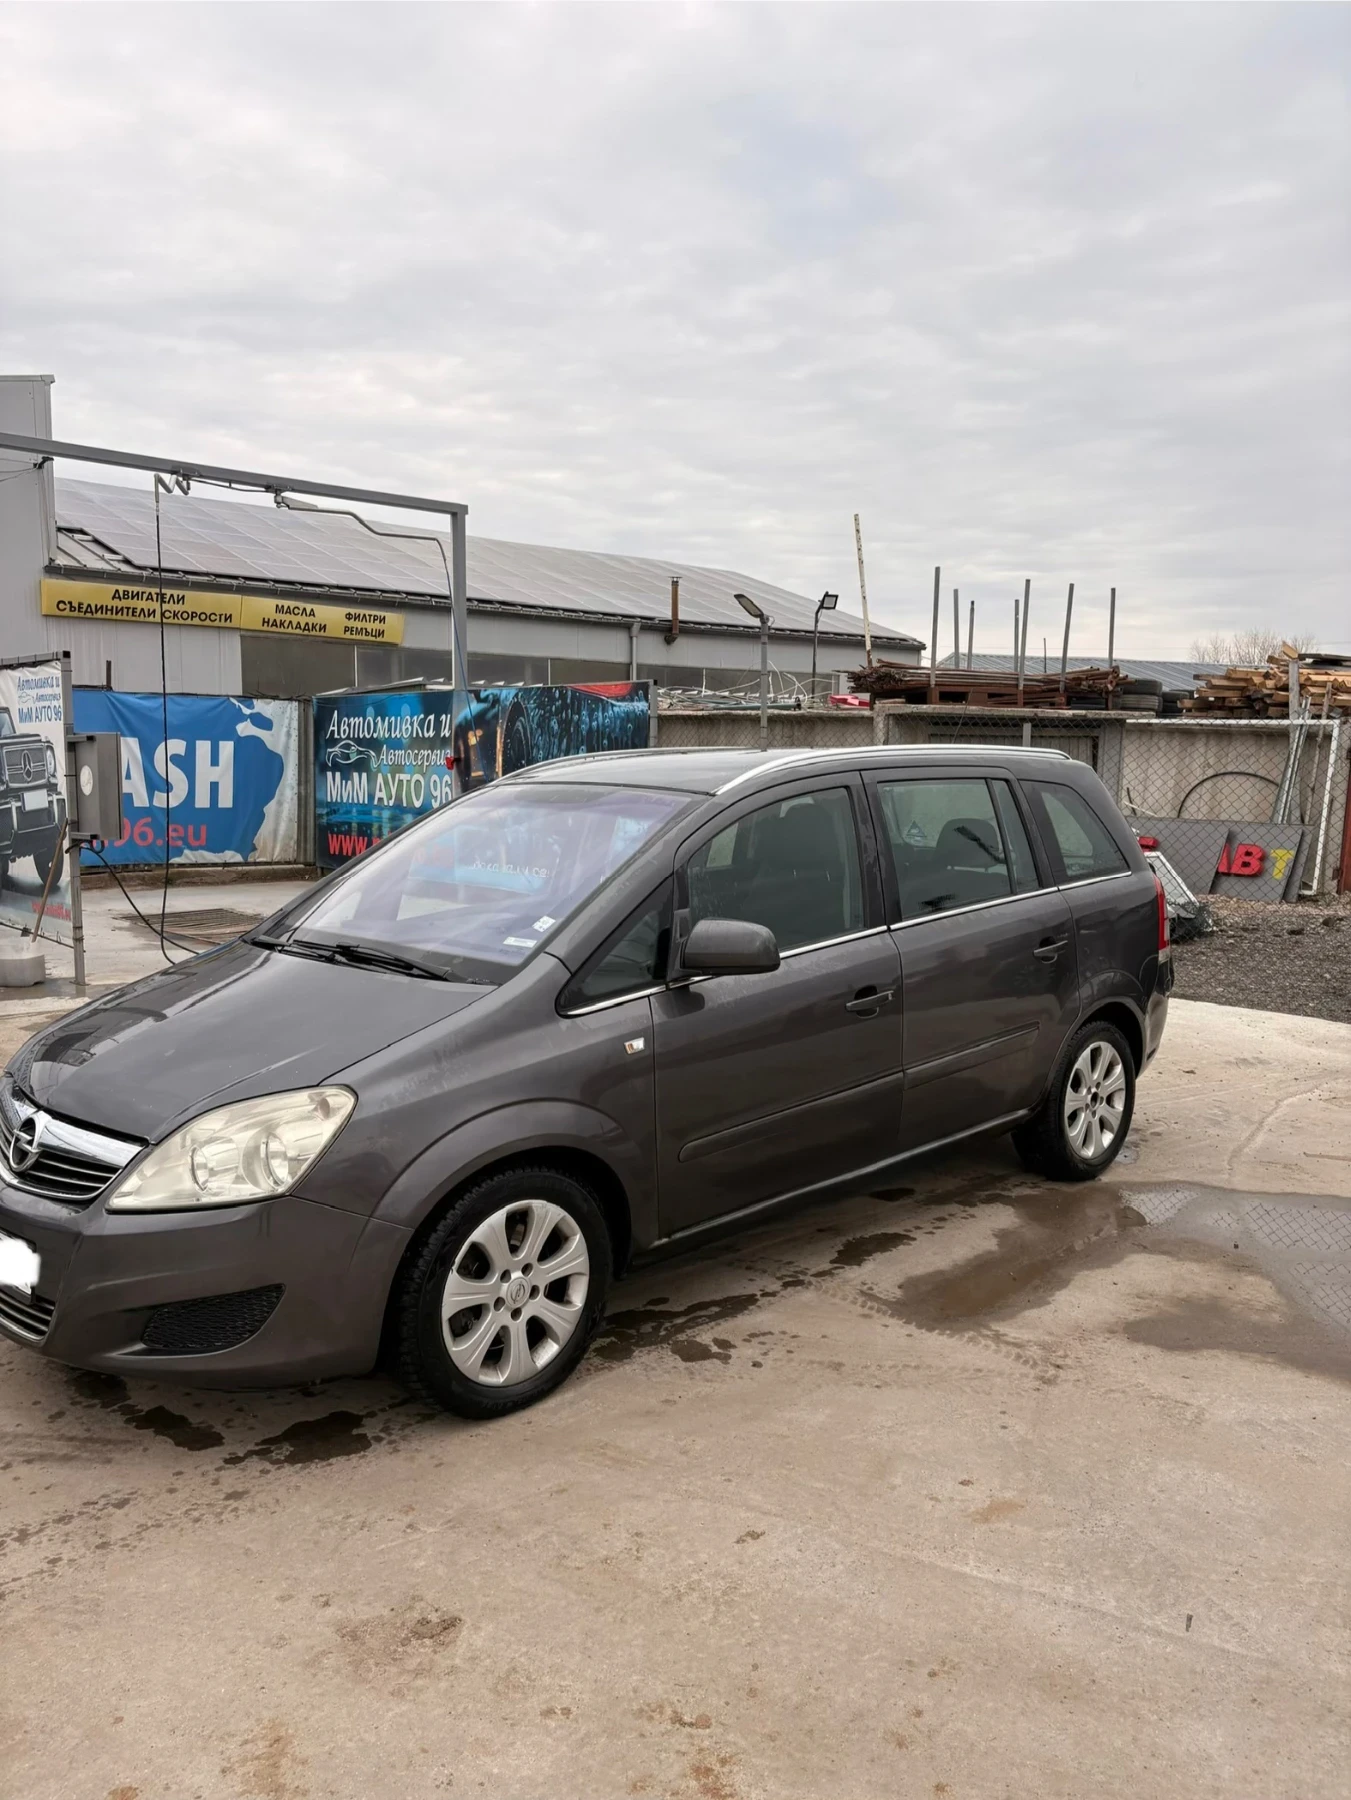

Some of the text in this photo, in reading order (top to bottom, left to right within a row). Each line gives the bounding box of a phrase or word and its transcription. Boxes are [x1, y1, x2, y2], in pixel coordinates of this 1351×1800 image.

[111, 589, 186, 605] ДВИГАТЕЛИ
[56, 600, 233, 623] СЪЕДИНИТЕЛИ СКОРОСТИ
[275, 604, 316, 618] МАСЛА
[345, 612, 386, 625] ФИЛТРИ
[261, 617, 327, 633] НАКЛАДКИ
[343, 625, 385, 639] РЕМЪЦИ
[326, 710, 451, 740] Автомивка и
[120, 736, 235, 809] ASH
[326, 771, 452, 808] МиМ АУТО 96
